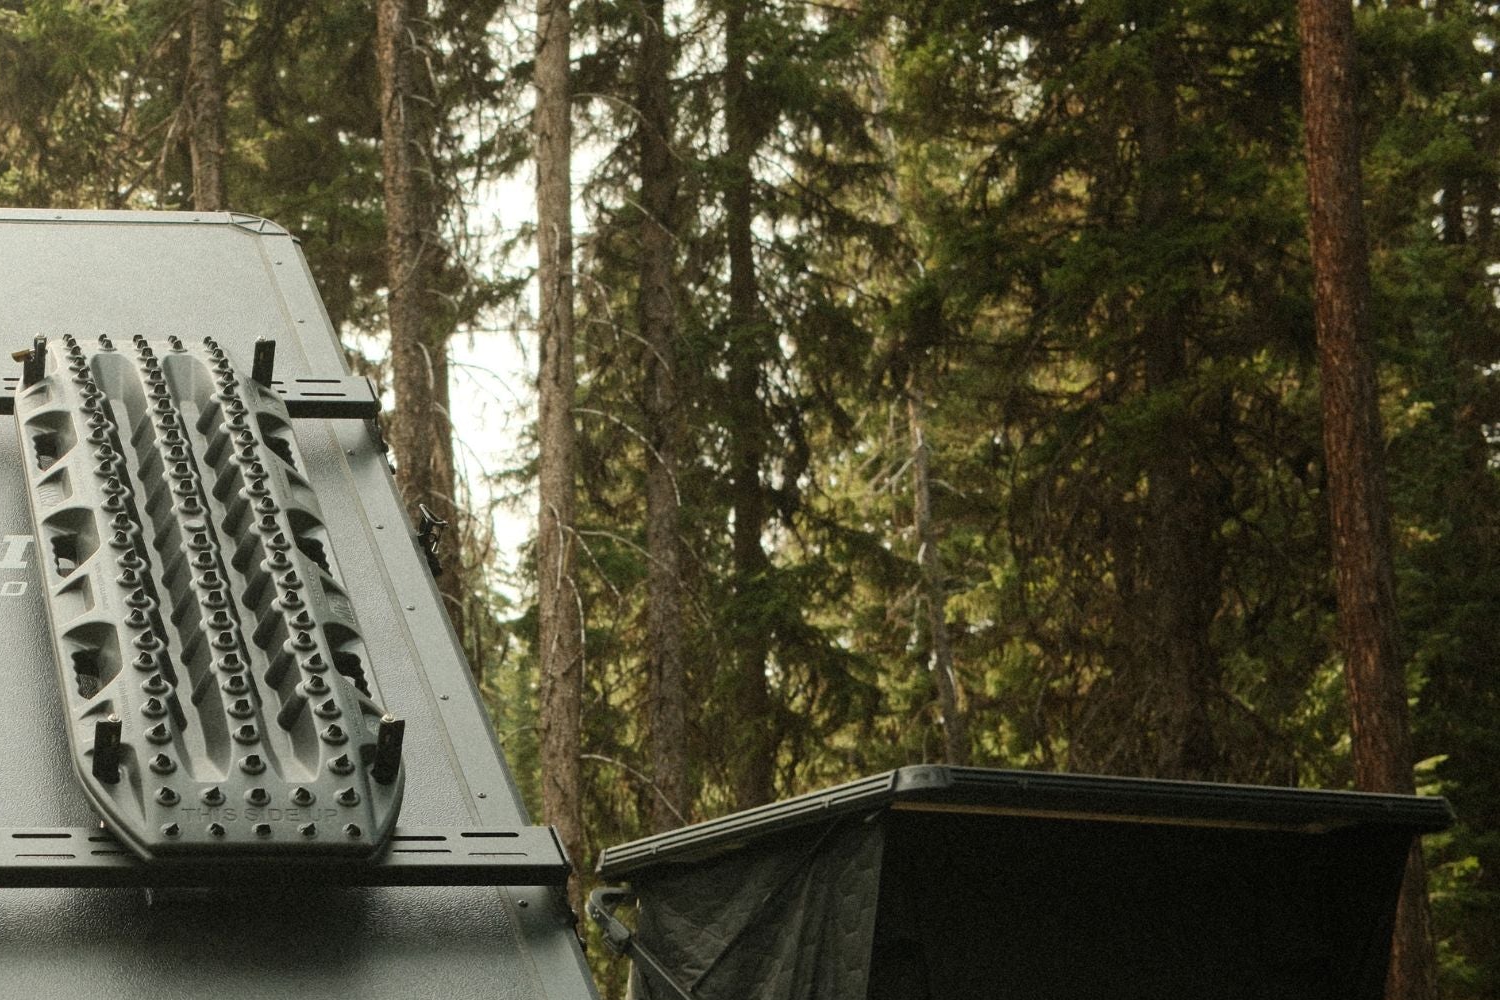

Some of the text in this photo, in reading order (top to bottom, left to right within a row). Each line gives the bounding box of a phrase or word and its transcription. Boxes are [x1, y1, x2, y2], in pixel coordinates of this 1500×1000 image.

[181, 807, 339, 822] THIS SIDE UP
